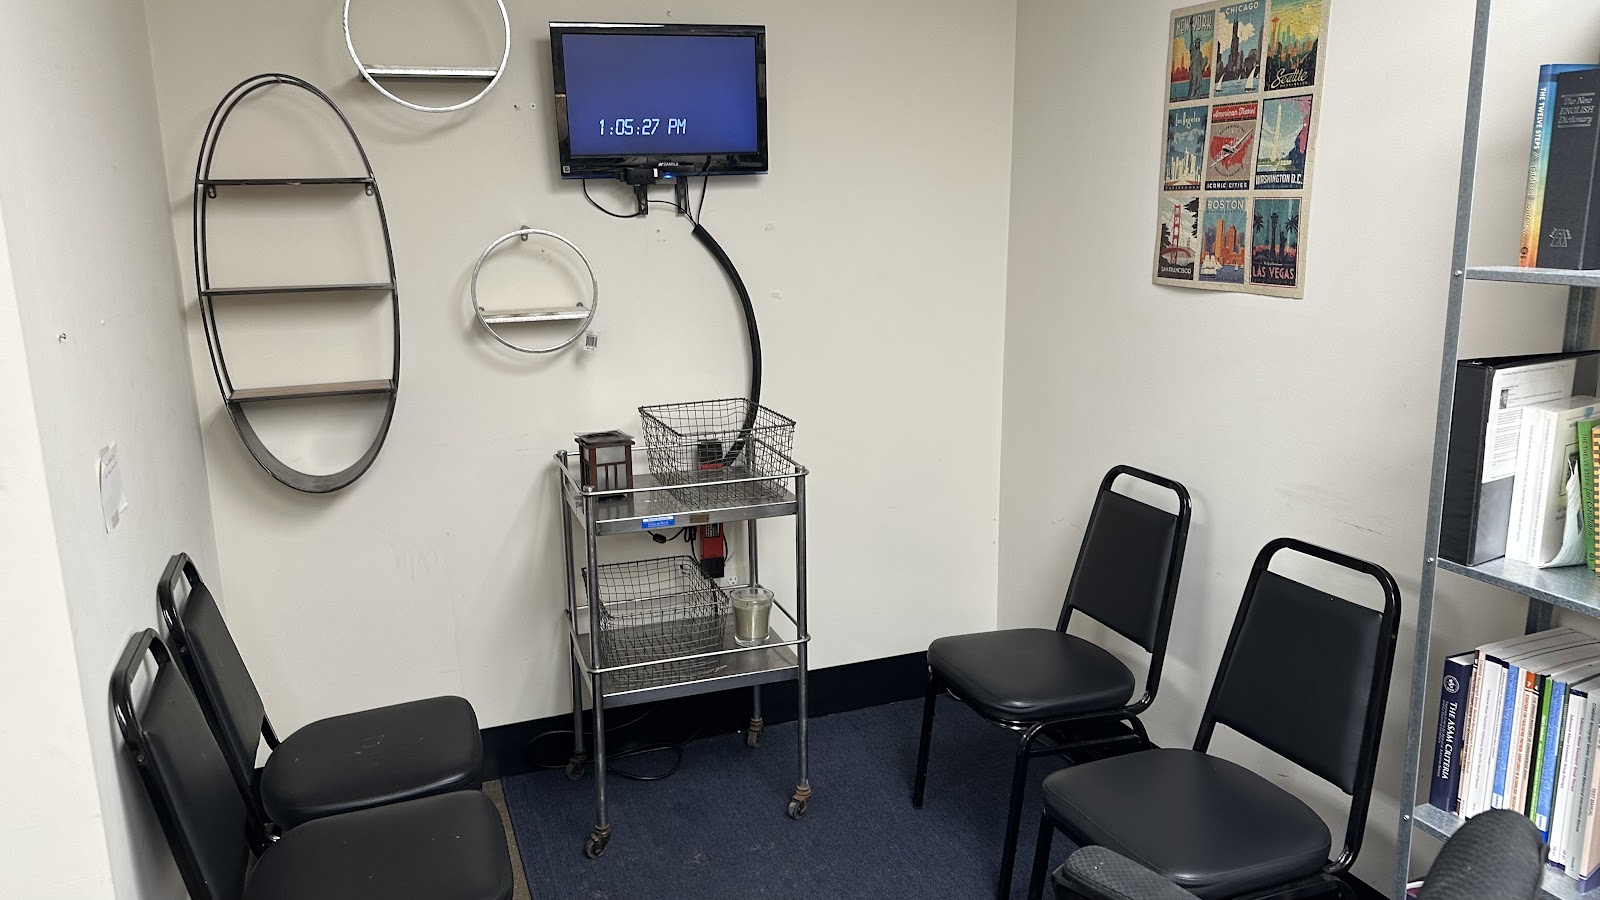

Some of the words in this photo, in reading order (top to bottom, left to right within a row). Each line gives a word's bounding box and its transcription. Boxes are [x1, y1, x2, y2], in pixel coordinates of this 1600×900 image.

[1225, 1, 1259, 15] CHICAGO
[1176, 17, 1190, 35] NEW
[1193, 14, 1212, 32] YORK
[1271, 68, 1308, 88] Seattle
[1563, 97, 1576, 105] The
[1577, 95, 1592, 104] New
[1212, 110, 1238, 118] American
[1239, 107, 1256, 116] Travel
[1535, 101, 1544, 127] TWELVE
[1559, 104, 1594, 115] ENGLISH
[599, 118, 660, 136] 1:05:27
[667, 118, 687, 135] PM
[1182, 110, 1200, 129] Angeles
[1557, 114, 1592, 124] Dictionary
[1533, 129, 1541, 149] STEPS
[1255, 174, 1291, 185] WASHINGTON
[1291, 173, 1303, 185] D.C.
[1526, 160, 1539, 197] Spiritual
[1207, 200, 1244, 210] BOSTON
[1521, 199, 1534, 235] Journey
[1169, 267, 1192, 275] FRANCISCO
[1252, 266, 1266, 278] LAS
[1269, 268, 1295, 280] VEGAS
[1583, 487, 1592, 498] for
[1585, 501, 1596, 536] Christians
[1448, 702, 1457, 718] THE
[1445, 718, 1455, 741] ASAM
[1441, 743, 1452, 778] CRITERIA
[1576, 796, 1584, 818] Intervention
